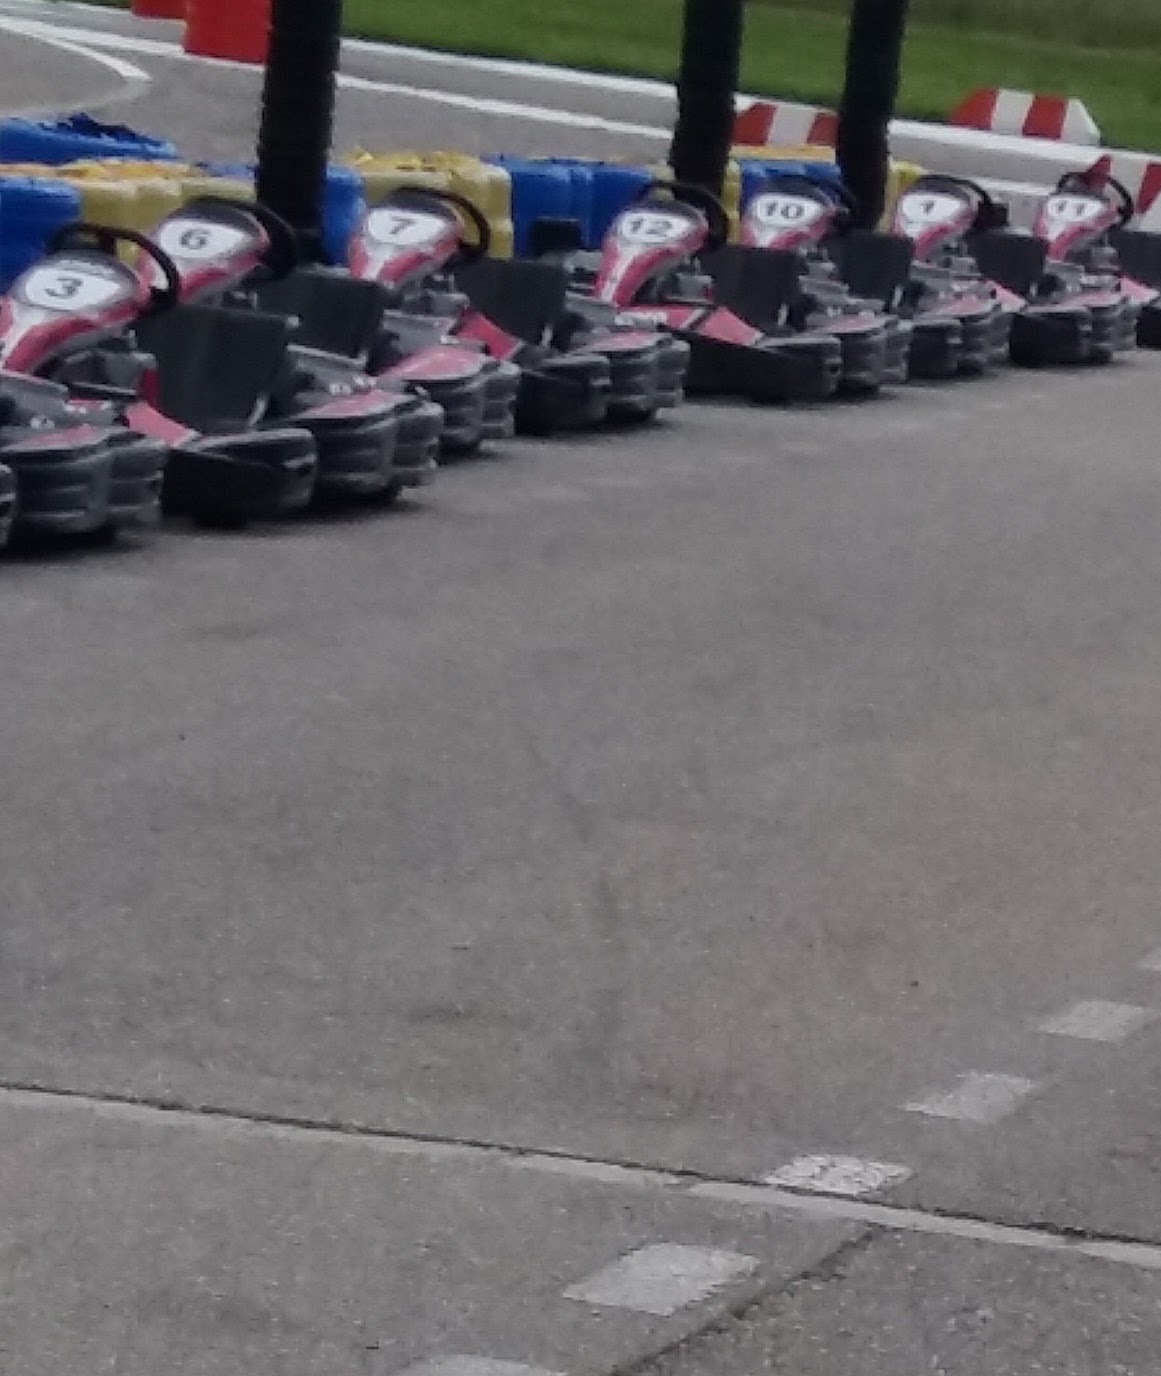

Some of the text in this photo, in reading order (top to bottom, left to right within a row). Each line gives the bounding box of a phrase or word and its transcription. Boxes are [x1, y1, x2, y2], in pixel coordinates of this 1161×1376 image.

[765, 199, 806, 220] 10
[1057, 199, 1086, 216] 11
[388, 215, 418, 235] 7
[629, 216, 675, 236] 12
[179, 227, 211, 250] 6
[44, 276, 84, 299] 3
